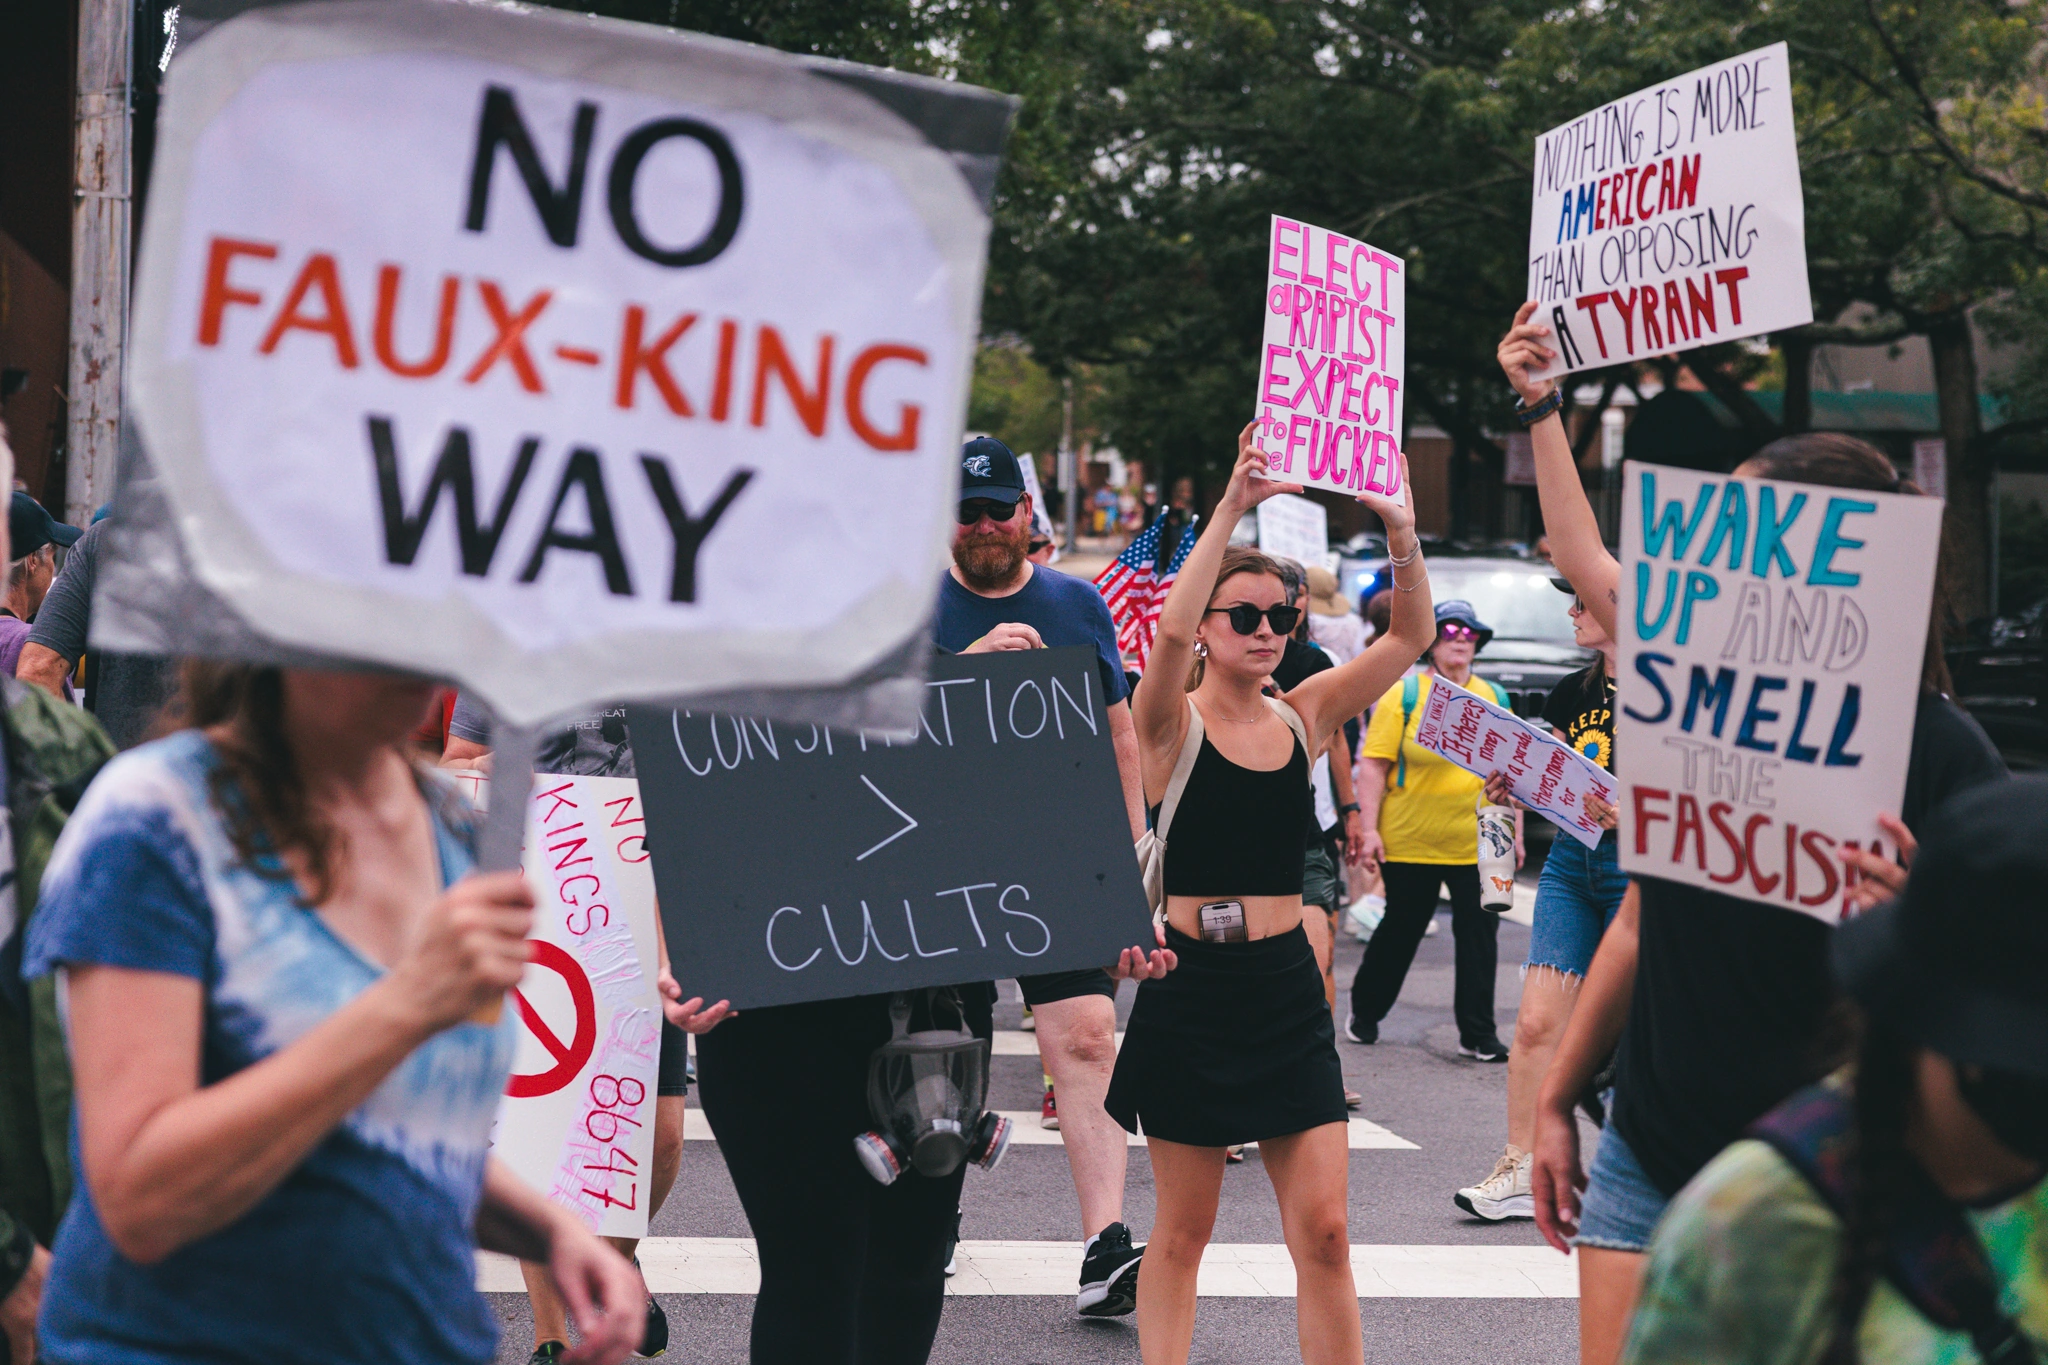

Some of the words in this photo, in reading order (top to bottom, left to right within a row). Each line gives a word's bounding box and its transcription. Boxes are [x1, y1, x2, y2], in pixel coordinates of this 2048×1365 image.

[1538, 98, 1646, 197] NOTHING
[1653, 88, 1680, 157] IS
[1690, 56, 1772, 143] MORE
[462, 84, 747, 269] NO
[1556, 153, 1702, 245] AMERICAN
[1272, 217, 1399, 312] ELECT
[1531, 241, 1585, 304] THAN
[1600, 204, 1759, 287] OPPOSING
[193, 236, 931, 453] FAUX-KING
[1289, 284, 1396, 372] RAPIST
[1552, 304, 1584, 370] A
[1575, 266, 1750, 359] TYRANT
[1261, 343, 1399, 432] EXPECT
[1259, 406, 1287, 440] to
[1283, 413, 1401, 497] FUCKED
[366, 414, 759, 604] WAY
[1640, 471, 1877, 588] WAKE
[1635, 561, 1720, 646] UP
[1719, 580, 1869, 672] AND
[1424, 722, 1438, 738] NO
[1429, 697, 1445, 722] KINGS
[1441, 731, 1473, 765] If
[1451, 699, 1486, 744] there's
[1479, 728, 1508, 763] money
[1512, 731, 1533, 770] parade
[1568, 709, 1611, 738] KEEP
[1622, 651, 1863, 767] SMELL
[1507, 763, 1524, 776] a
[1545, 746, 1573, 781] money
[1558, 786, 1576, 808] for
[1664, 736, 1782, 810] THE
[536, 782, 610, 936] KINGS
[604, 796, 650, 864] NO
[766, 883, 1051, 972] CULTS
[1212, 914, 1232, 925] 1:39
[581, 1074, 646, 1211] 8647
